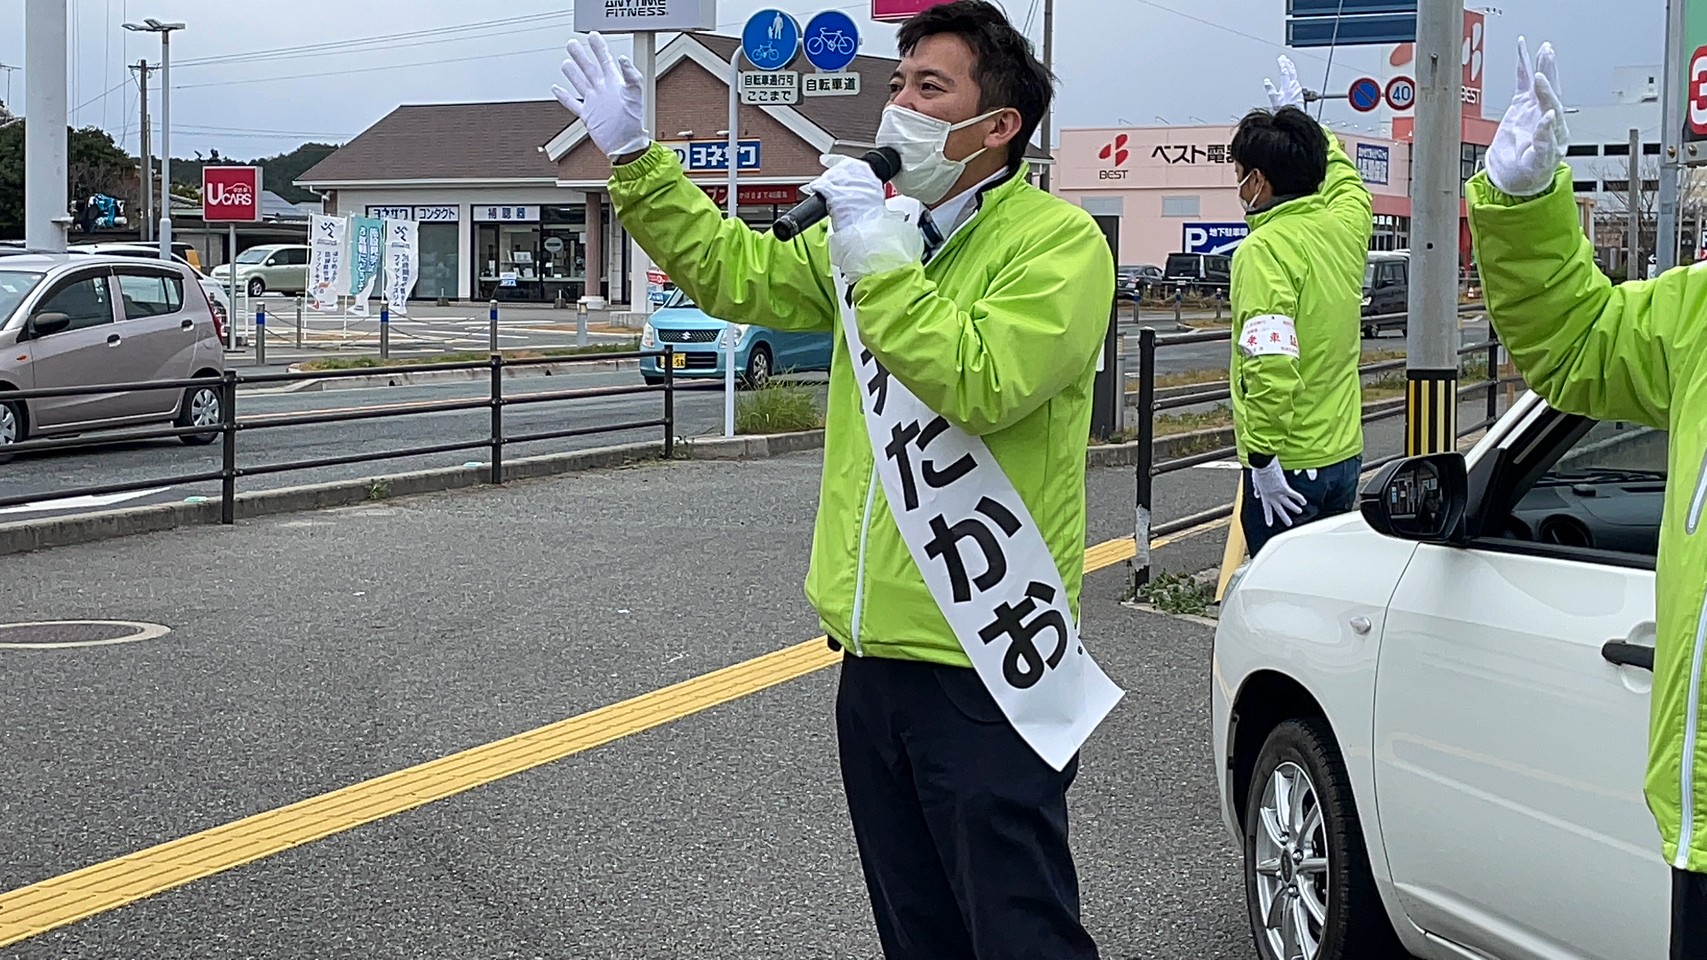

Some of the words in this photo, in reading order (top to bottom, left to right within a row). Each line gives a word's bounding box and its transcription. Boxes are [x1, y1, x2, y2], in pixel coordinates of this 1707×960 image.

[605, 0, 667, 8] ANYTIME
[606, 7, 667, 18] FITNESS
[744, 75, 795, 86] 自転車通行可
[806, 78, 857, 92] 自転車道
[747, 90, 792, 102] ここまで
[1393, 85, 1411, 102] 40
[1099, 170, 1128, 180] BEST
[419, 208, 455, 219] コンタクト
[488, 207, 526, 219] 補聴器
[1185, 227, 1208, 253] P
